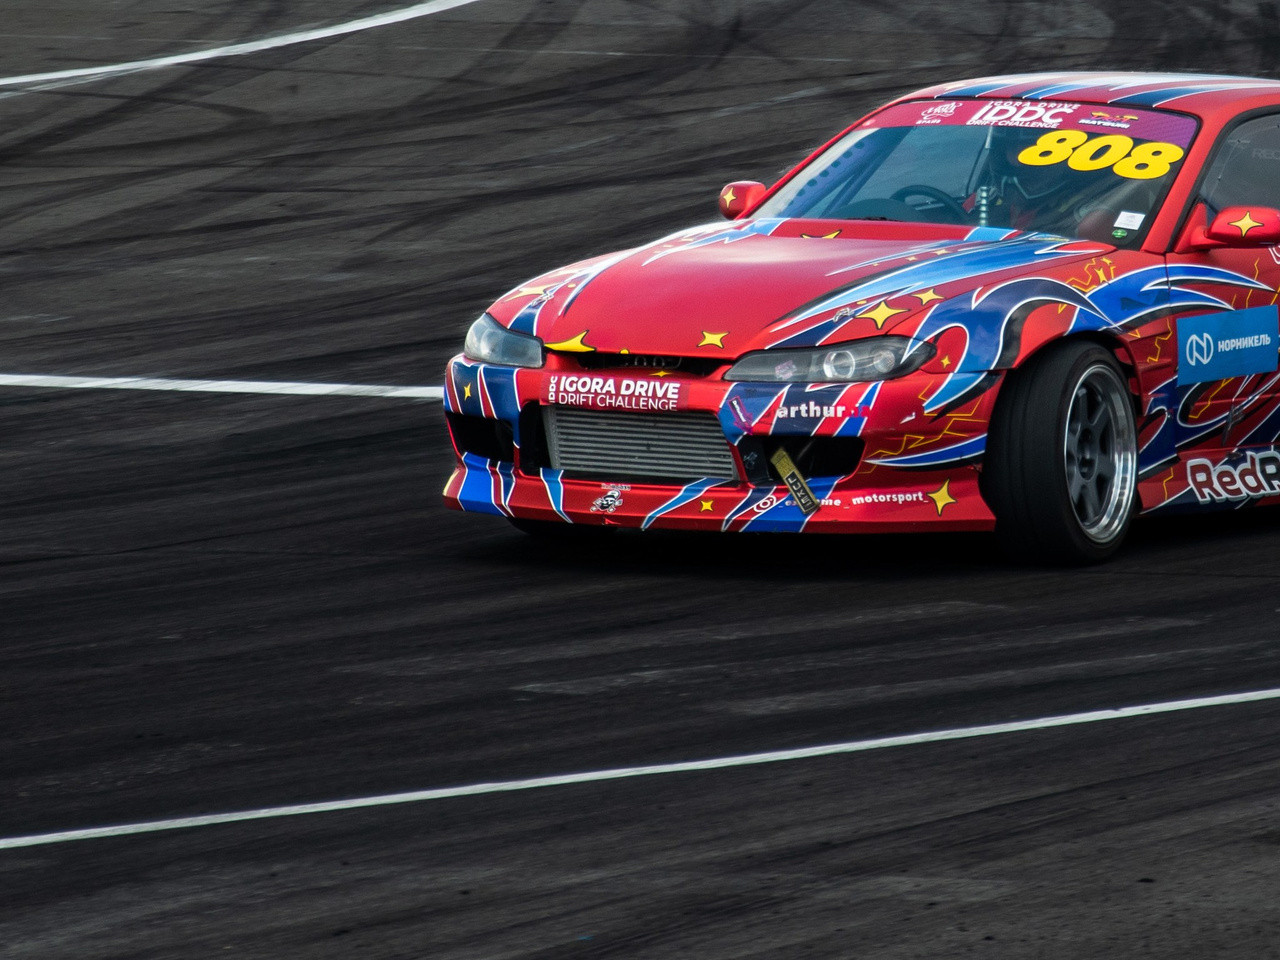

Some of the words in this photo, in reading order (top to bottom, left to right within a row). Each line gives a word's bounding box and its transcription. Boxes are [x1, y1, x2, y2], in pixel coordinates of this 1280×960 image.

[971, 105, 1074, 124] IDDC
[998, 120, 1060, 129] CHALLENGE
[1018, 129, 1184, 179] 808
[1217, 333, 1271, 353] НОРНИКЕЛЬ
[559, 376, 616, 394] IGORA
[620, 379, 681, 399] DRIVE
[558, 392, 595, 406] DRIFT
[597, 394, 679, 411] CHALLENGE
